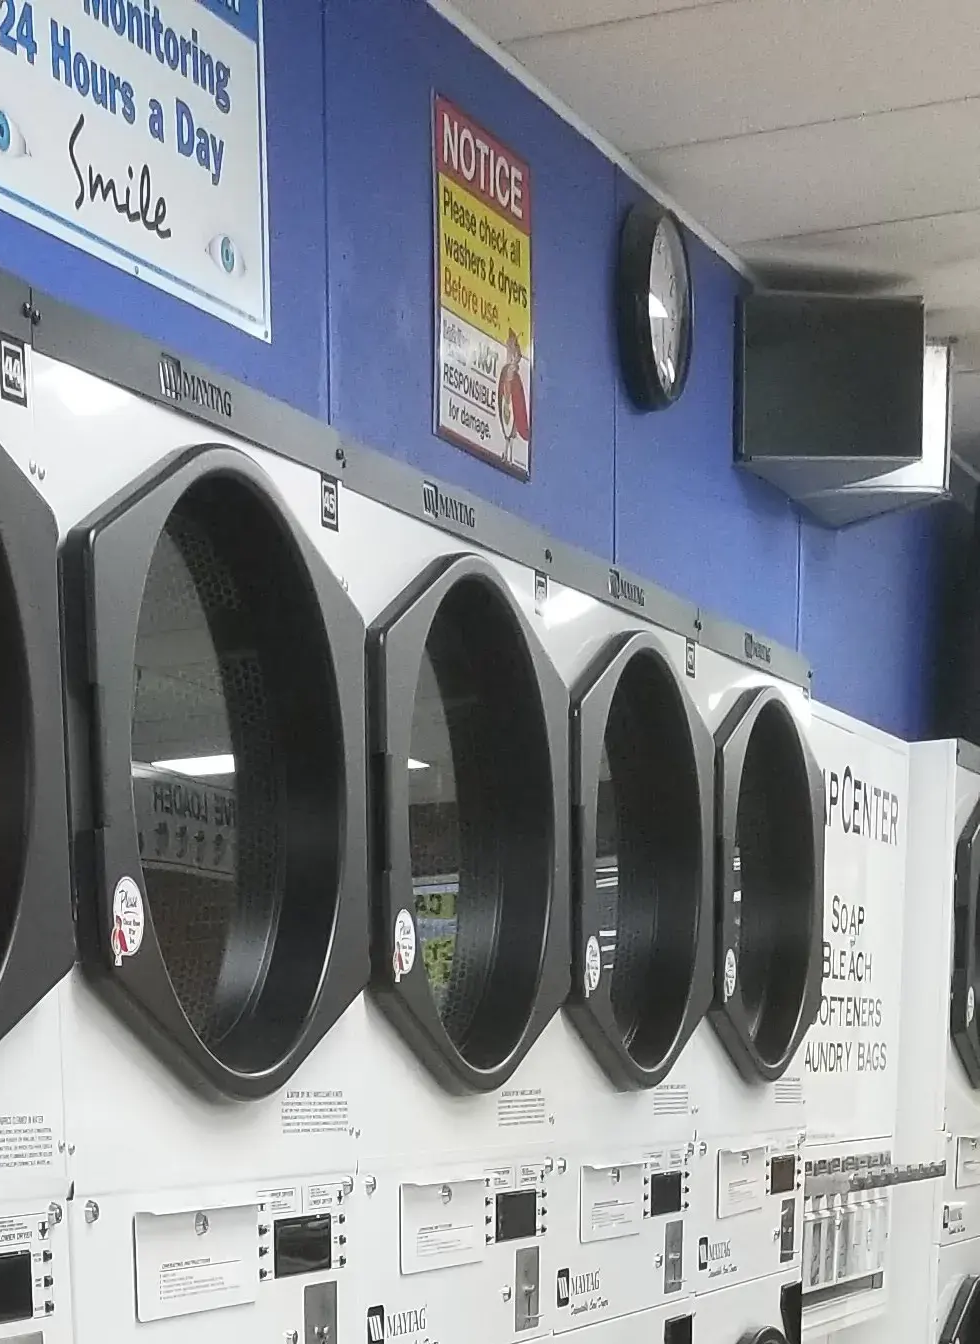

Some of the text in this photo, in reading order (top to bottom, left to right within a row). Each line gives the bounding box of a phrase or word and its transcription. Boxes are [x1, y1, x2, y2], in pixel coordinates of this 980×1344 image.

[50, 18, 135, 124] Hours
[149, 98, 164, 143] a
[176, 97, 224, 186] Day
[69, 114, 171, 239] Smile
[443, 113, 523, 219] NOTICE
[443, 186, 521, 268] Please check all
[444, 233, 528, 309] washers & dryers
[444, 266, 478, 315] Before
[4, 353, 21, 384] 44
[478, 343, 499, 377] NOT
[182, 365, 232, 418] MAYTAG
[443, 363, 496, 410] RESPONSIBLE
[448, 396, 492, 440] for damage.
[439, 493, 476, 528] MAYTAG
[841, 765, 899, 847] CENTER
[831, 894, 865, 936] SOAP
[823, 941, 872, 983] BLEACH
[819, 995, 882, 1027] OFTENERS
[805, 1041, 887, 1073] AUNDRY BAGS
[386, 1307, 426, 1339] MAYTAG
